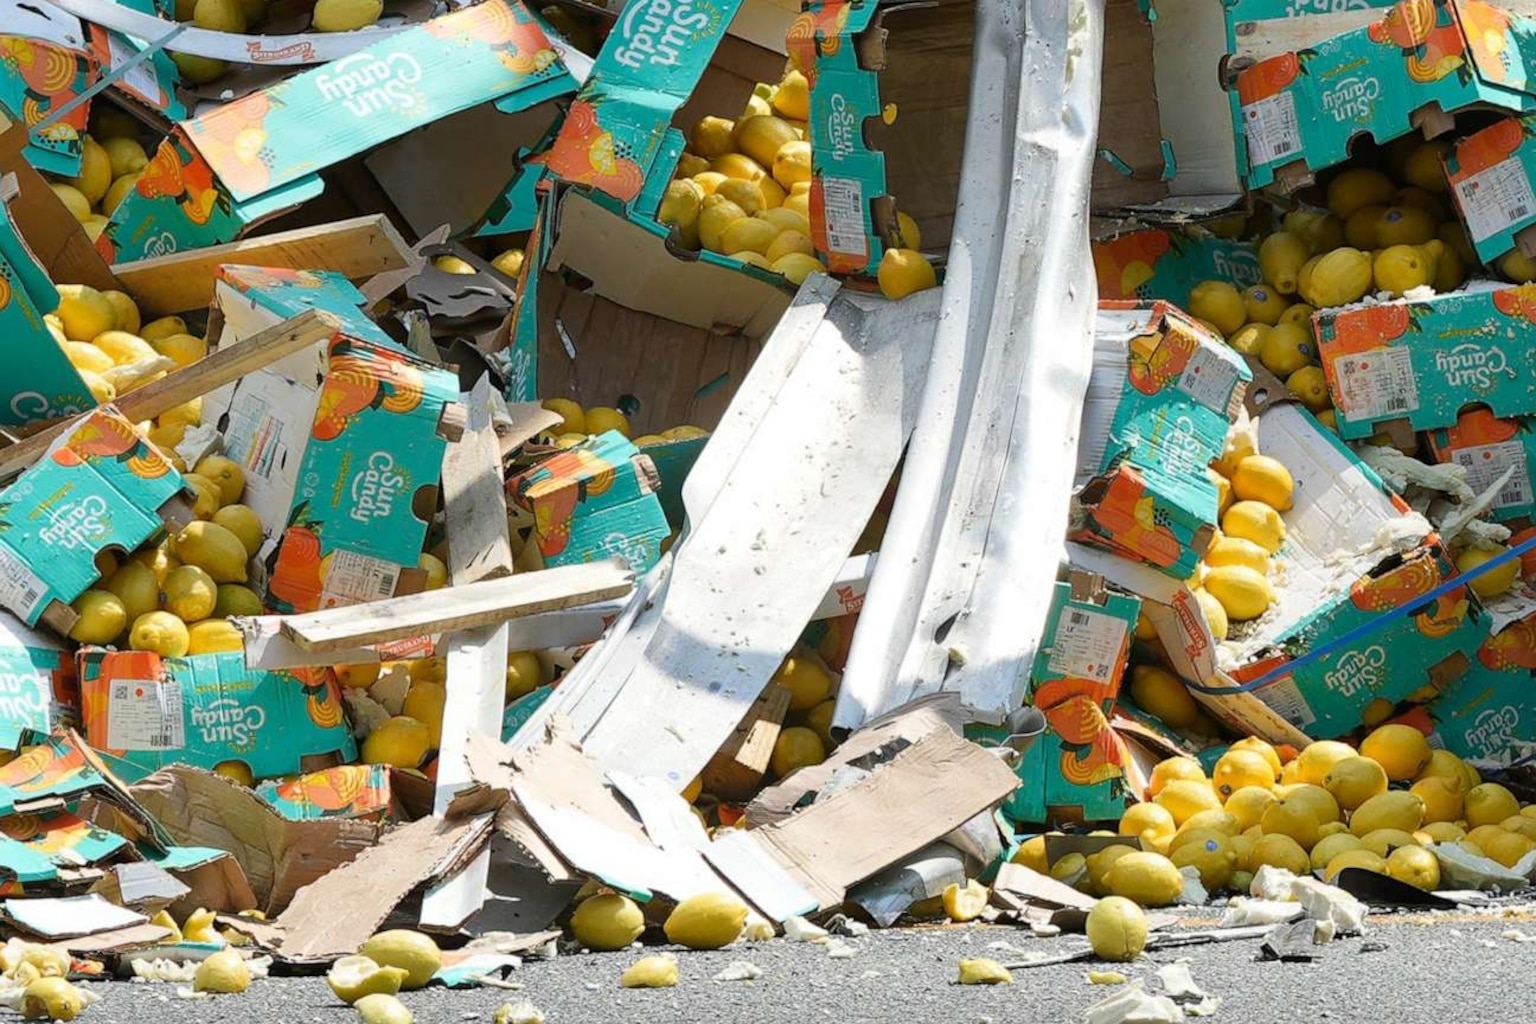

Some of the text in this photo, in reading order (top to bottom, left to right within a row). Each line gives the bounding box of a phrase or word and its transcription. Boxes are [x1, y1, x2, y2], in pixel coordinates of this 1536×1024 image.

[649, 4, 709, 66] Sun
[315, 52, 422, 101] Candy
[1322, 77, 1379, 111] Candy
[343, 79, 414, 117] Sun
[1331, 97, 1370, 122] Sun
[830, 93, 846, 162] Candy
[841, 113, 855, 156] Sun
[1435, 345, 1506, 373] Candy
[1446, 367, 1492, 389] Sun
[350, 451, 395, 524] Candy
[373, 471, 404, 517] Sun
[38, 495, 107, 547] Candy
[60, 514, 107, 549] Sun
[1324, 645, 1386, 690] Candy
[1339, 665, 1378, 697] Sun
[190, 705, 266, 730] Candy
[201, 724, 249, 746] Sun
[1464, 705, 1519, 748] Candy
